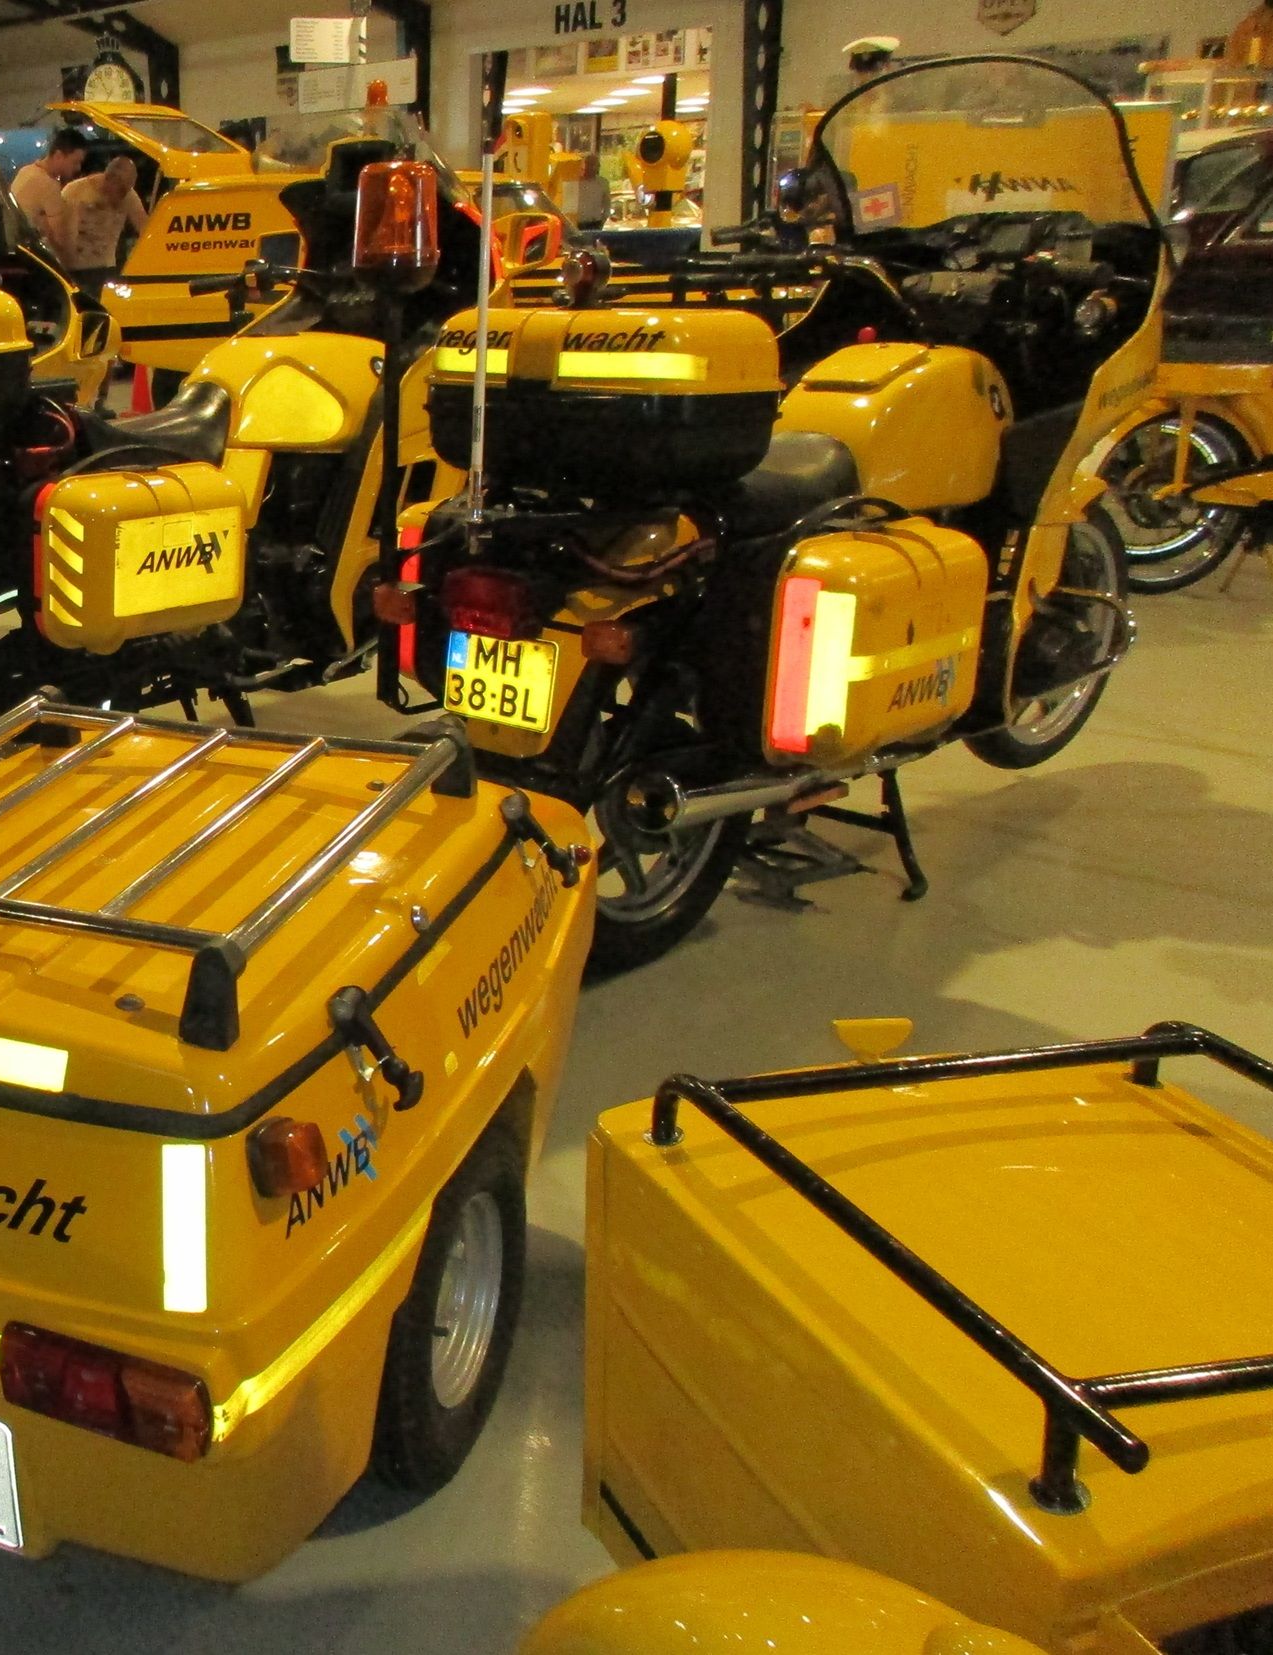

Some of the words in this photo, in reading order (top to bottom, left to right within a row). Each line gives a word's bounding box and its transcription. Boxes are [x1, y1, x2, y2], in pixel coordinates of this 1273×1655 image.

[555, 0, 602, 34] HAL
[611, 0, 627, 27] 3
[168, 212, 252, 234] ANWB
[474, 637, 522, 678] MH
[457, 863, 559, 1040] wegenwacht
[286, 1131, 370, 1240] ANWB
